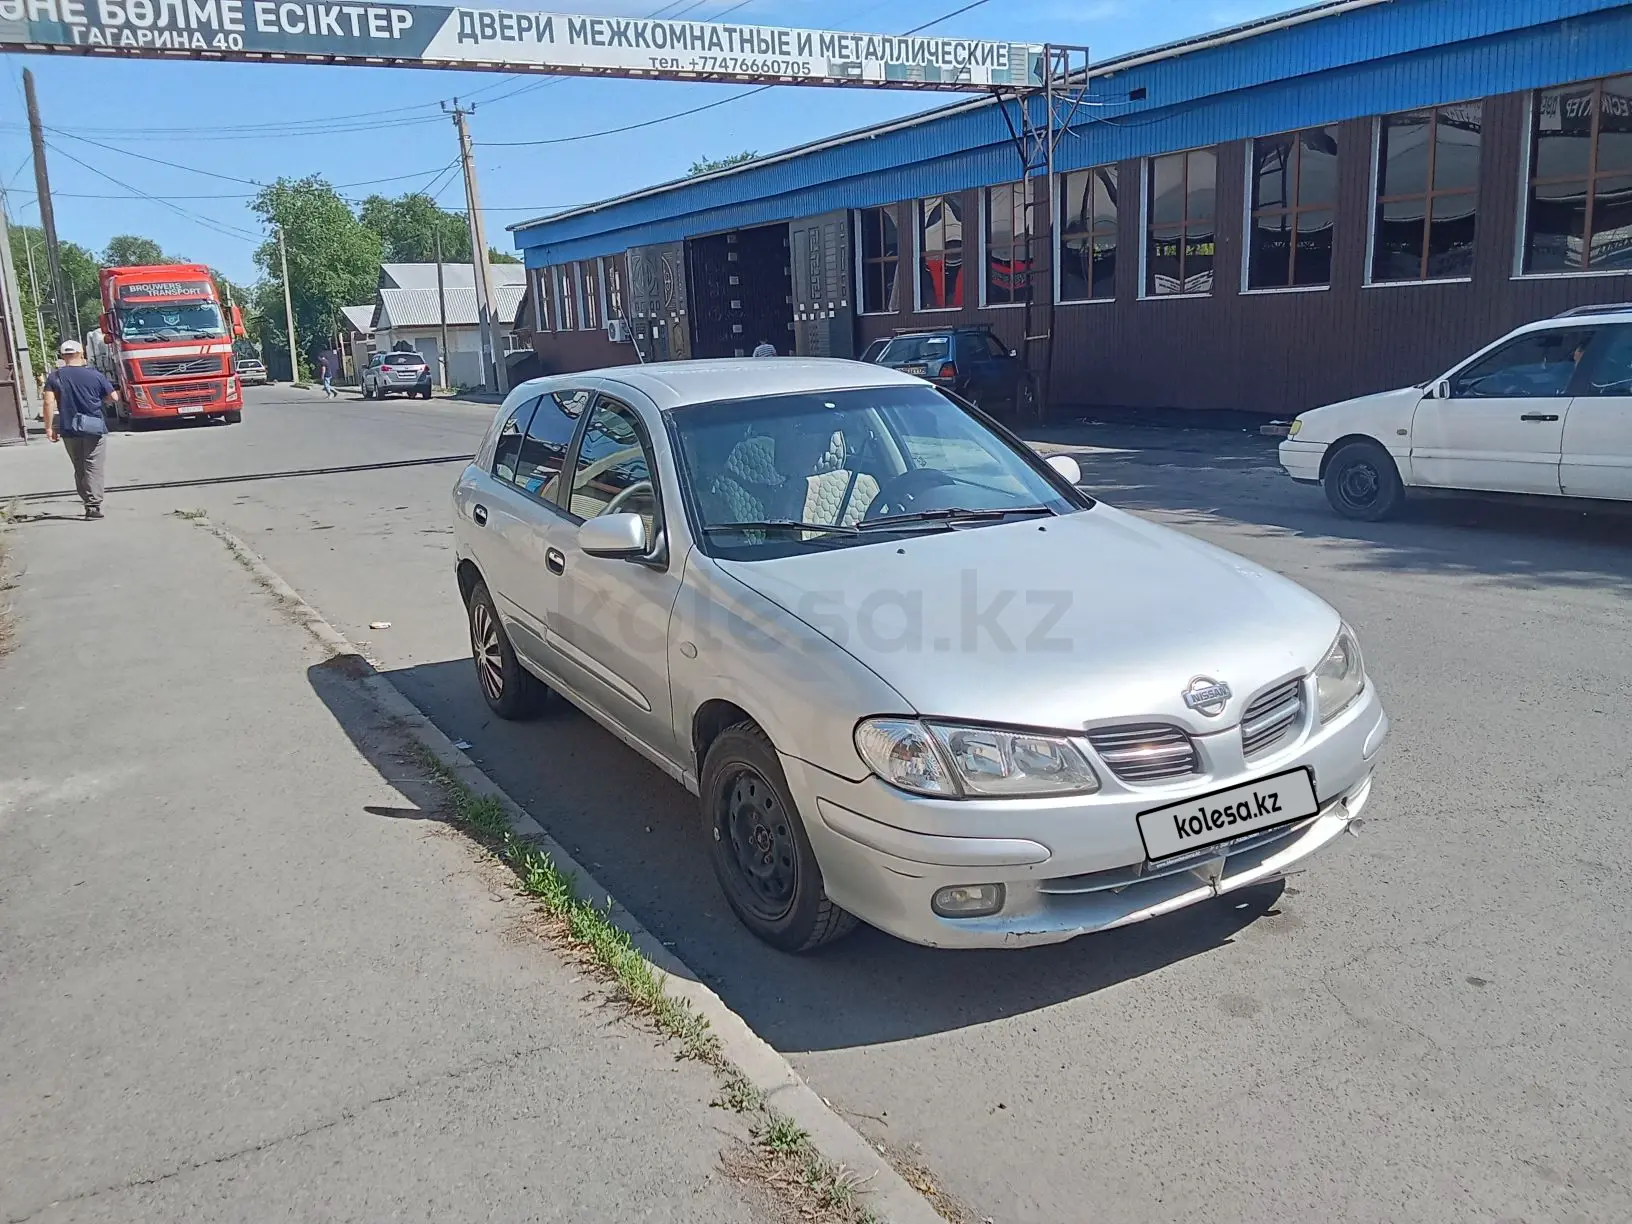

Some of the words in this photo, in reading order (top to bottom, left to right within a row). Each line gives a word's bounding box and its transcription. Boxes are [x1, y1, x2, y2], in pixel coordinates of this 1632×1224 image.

[98, 0, 245, 31] БӨЛМЕ
[254, 2, 413, 39] ЕСІКТЕР
[71, 26, 207, 49] ГАГАРИНА
[212, 33, 243, 51] 40
[457, 11, 555, 45] ДВЕРИ
[567, 18, 790, 56] МЕЖКОМНАТНЫЕ
[798, 32, 813, 57] И
[819, 34, 1008, 67] МЕТАЛЛИЧЕСКИЕ
[650, 56, 684, 69] тел.
[688, 56, 811, 75] +77476660705
[129, 283, 181, 293] BROUWERS
[147, 288, 201, 297] TRANSPORT
[1190, 687, 1228, 704] NISSAN
